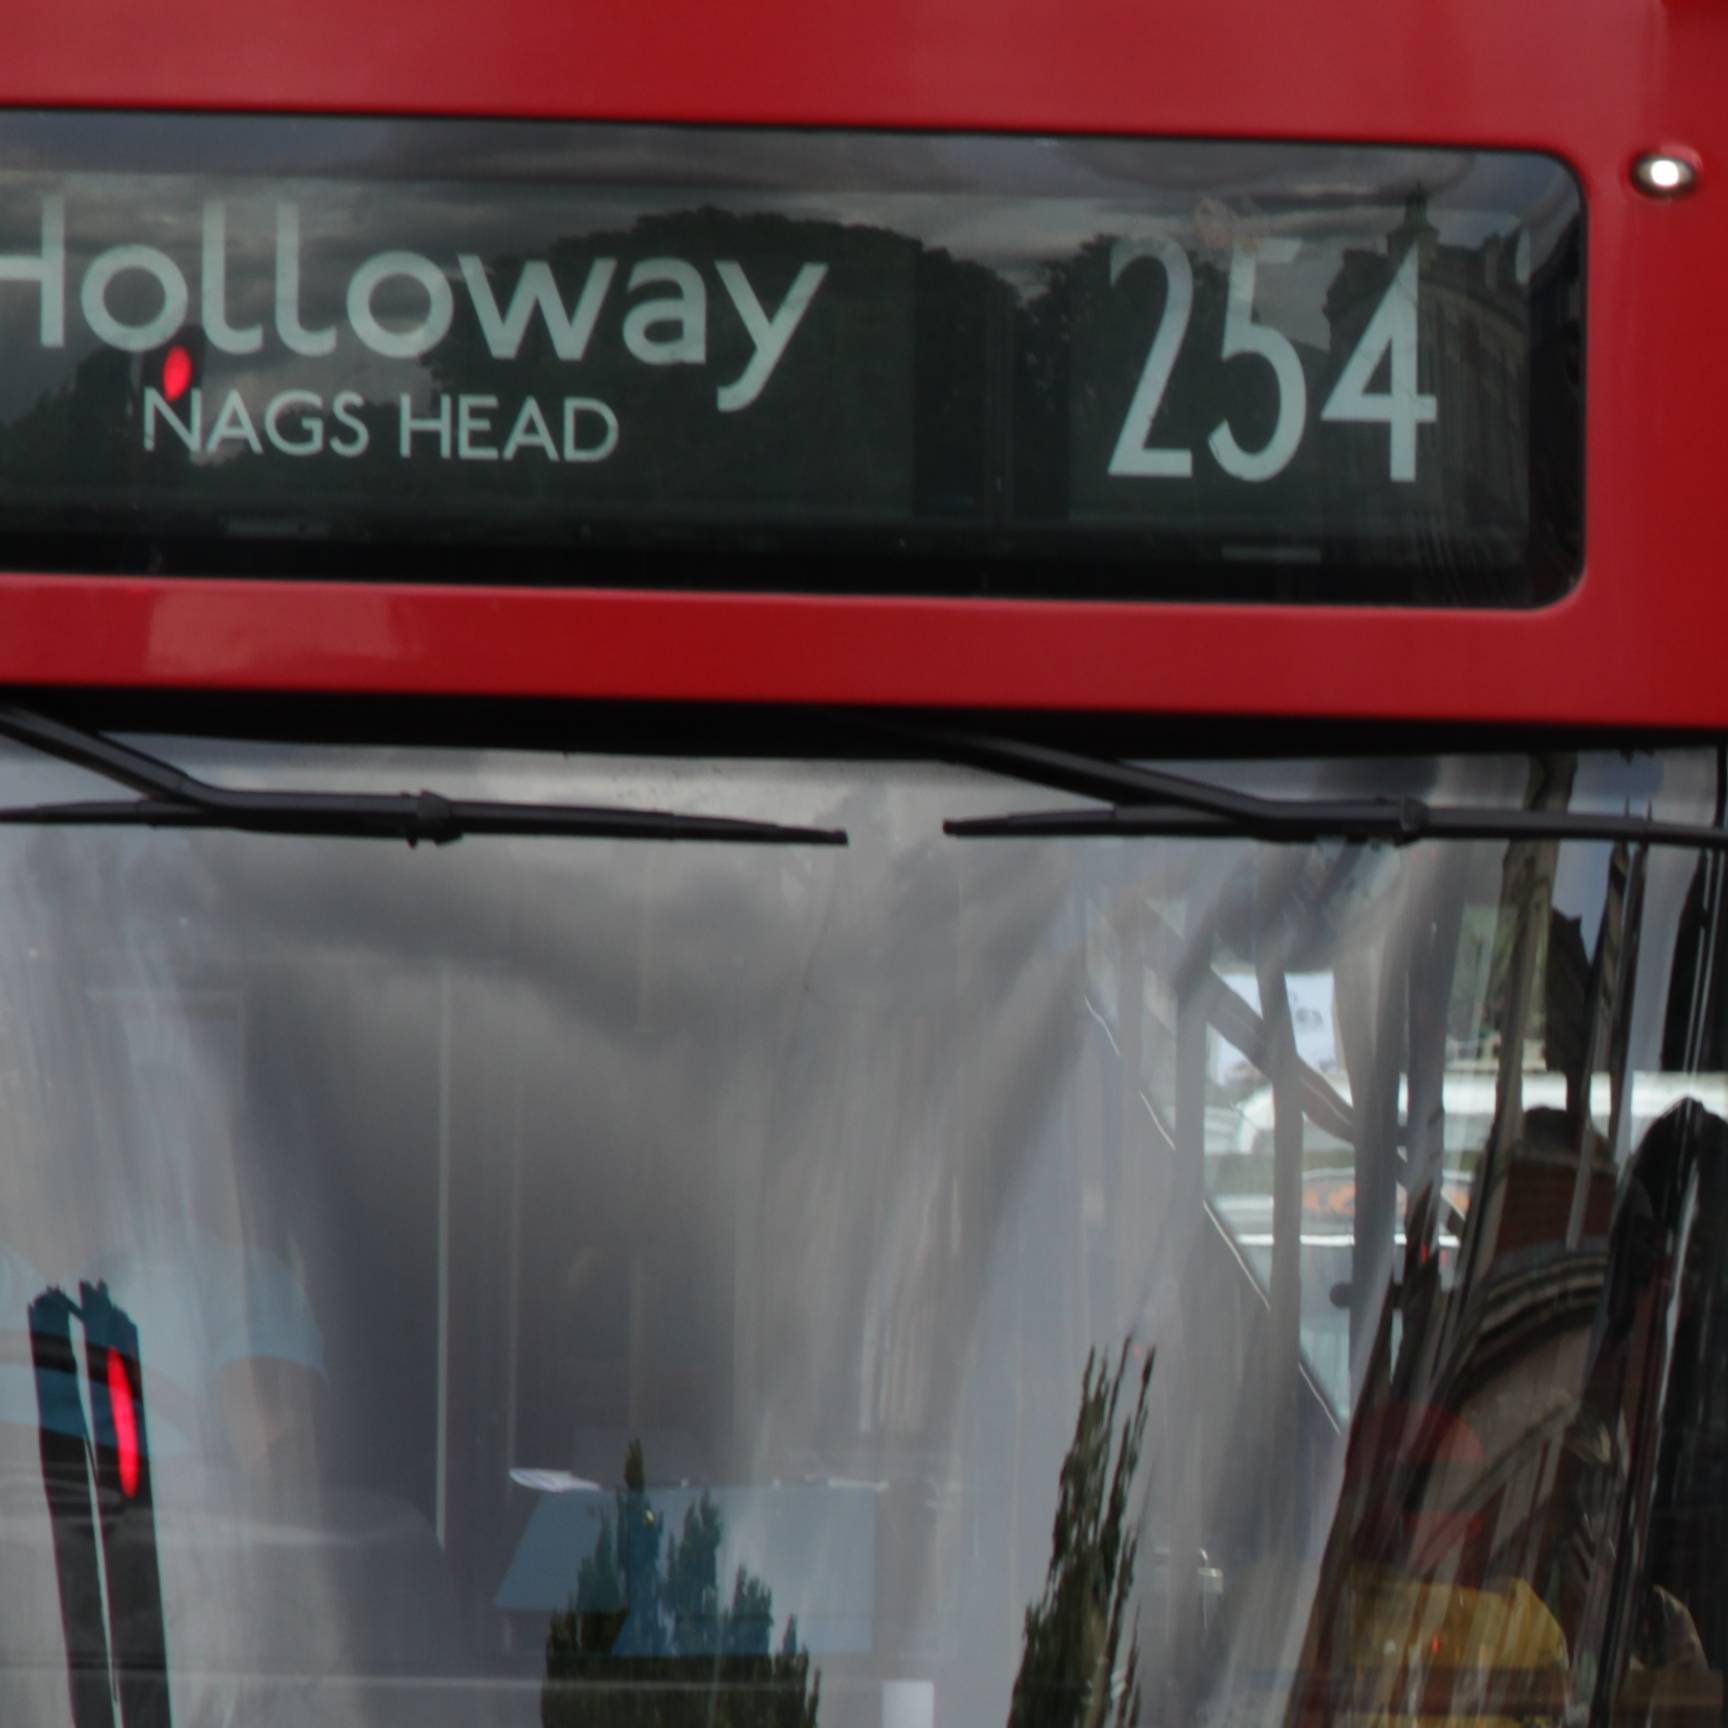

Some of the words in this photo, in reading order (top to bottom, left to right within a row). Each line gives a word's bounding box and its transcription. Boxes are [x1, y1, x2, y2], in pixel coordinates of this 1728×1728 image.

[0, 198, 828, 411] Holloway
[1108, 237, 1438, 482] 254
[143, 386, 370, 458] NAGS
[400, 391, 619, 462] HEAD
